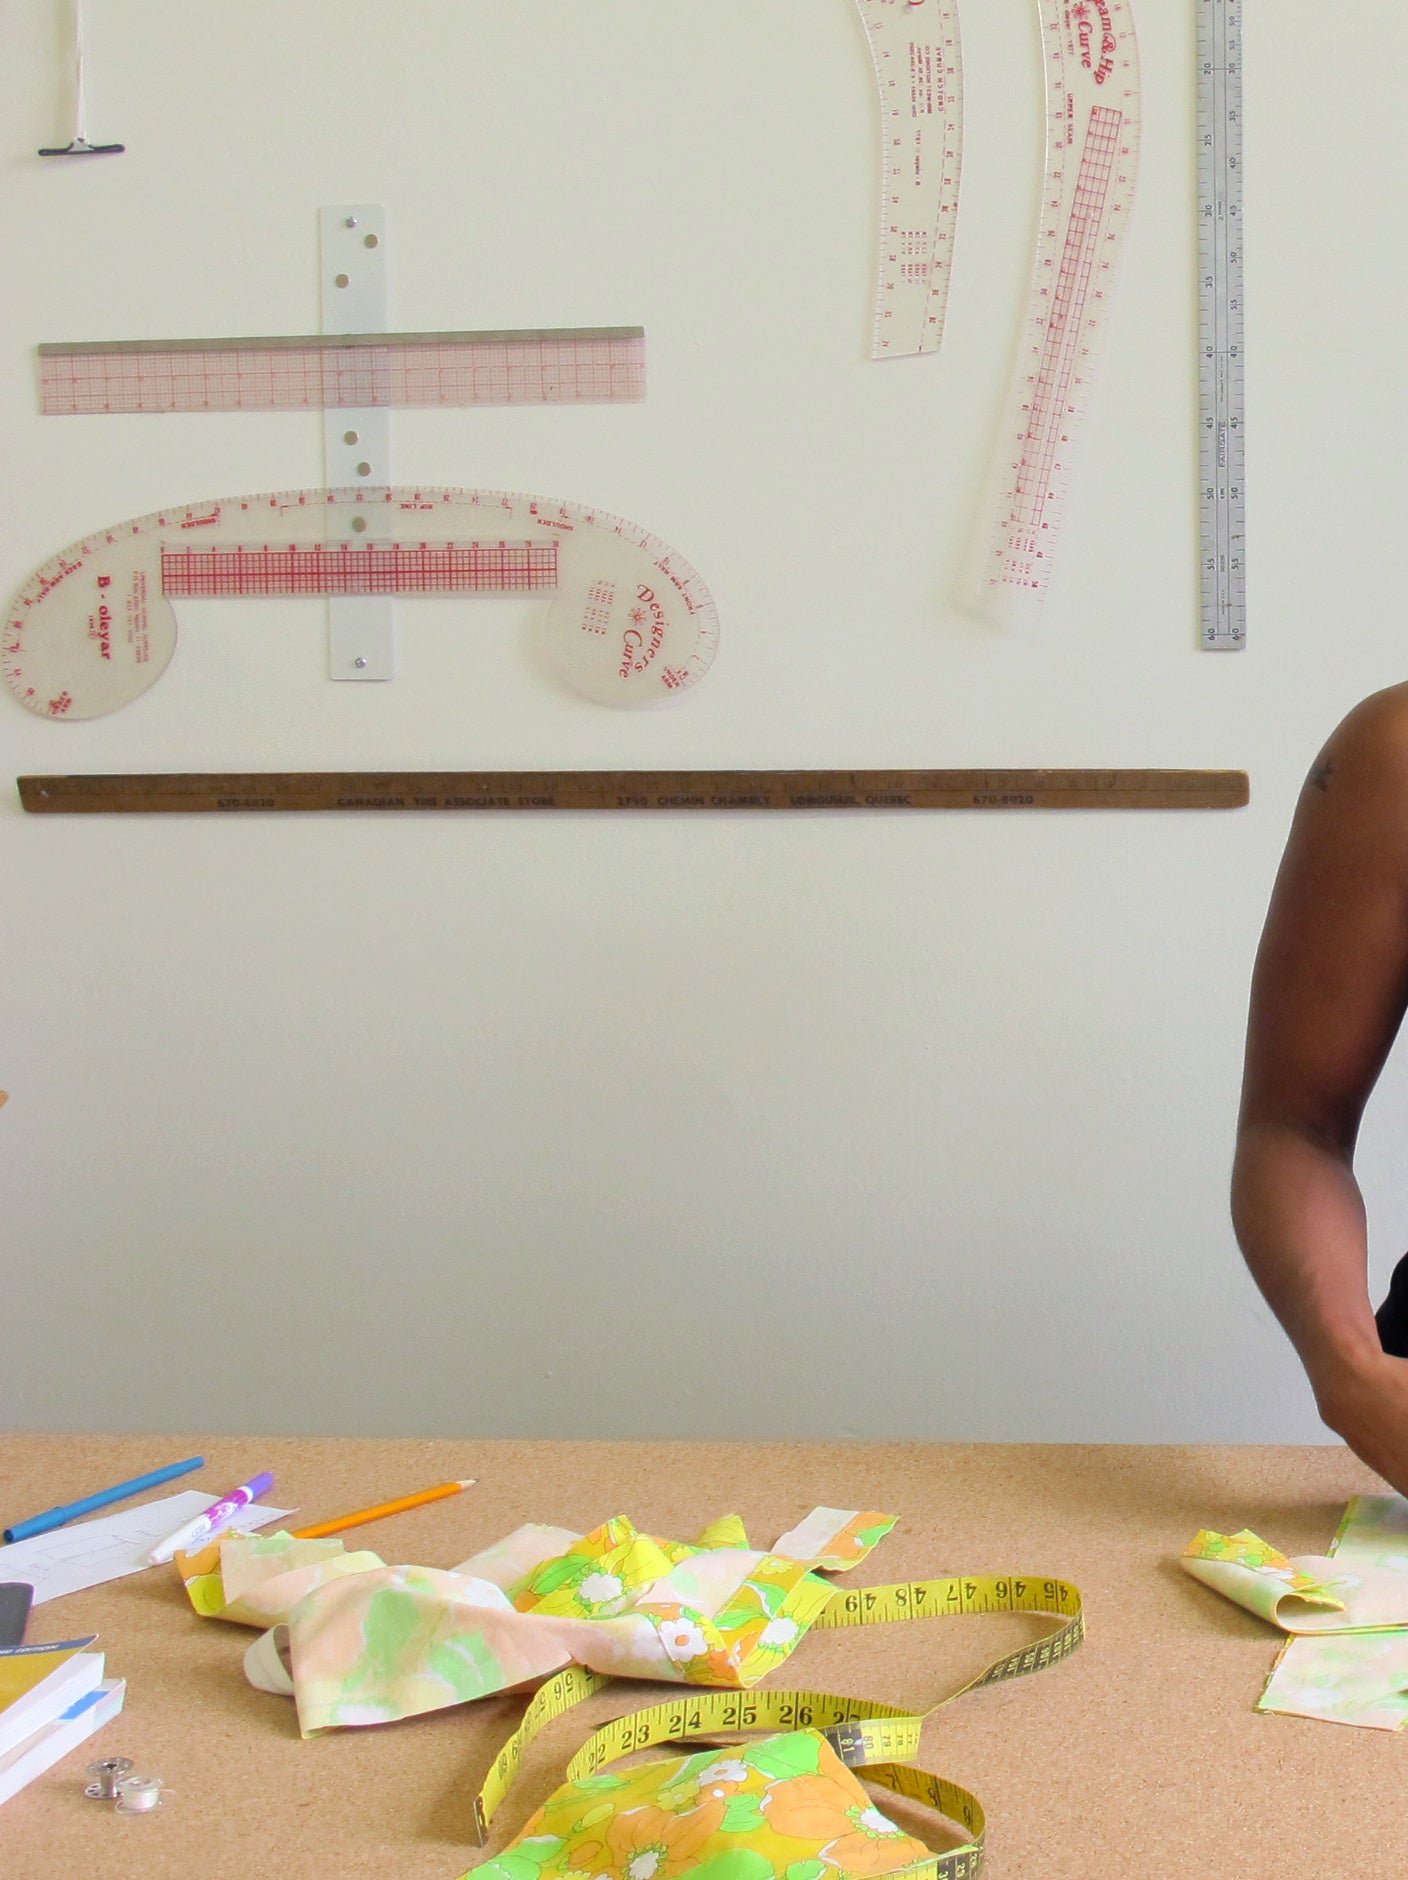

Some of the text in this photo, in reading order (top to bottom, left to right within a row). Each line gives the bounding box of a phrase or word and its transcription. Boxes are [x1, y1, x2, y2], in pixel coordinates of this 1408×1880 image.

[1078, 21, 1093, 68] Curve
[1094, 56, 1115, 84] Hip
[1229, 110, 1236, 121] 35
[1229, 157, 1236, 169] 40
[1229, 205, 1237, 216] 45
[1230, 251, 1237, 263] 50
[1203, 63, 1216, 641] 20 25 30 35 40 45 50 55 60
[1230, 345, 1237, 358] 40
[1230, 416, 1238, 429] 45
[1230, 487, 1238, 500] 50
[537, 518, 574, 532] SHOULDER
[1231, 558, 1239, 570] 55
[97, 576, 111, 588] B
[98, 605, 112, 660] oleyar
[635, 584, 667, 672] Designers
[1232, 628, 1240, 641] 60
[619, 629, 643, 678] Curve
[337, 797, 406, 807] CANADIAN
[445, 796, 511, 806] ASSOCIATE
[845, 1580, 1069, 1613] 45 46 47 48 49
[587, 1744, 606, 1773] 22
[621, 1724, 651, 1750] 23
[668, 1711, 702, 1734] 24
[722, 1705, 758, 1726] 25
[779, 1705, 813, 1726] 26
[841, 1737, 856, 1752] 81
[863, 1735, 875, 1750] 80
[882, 1735, 891, 1747] 79
